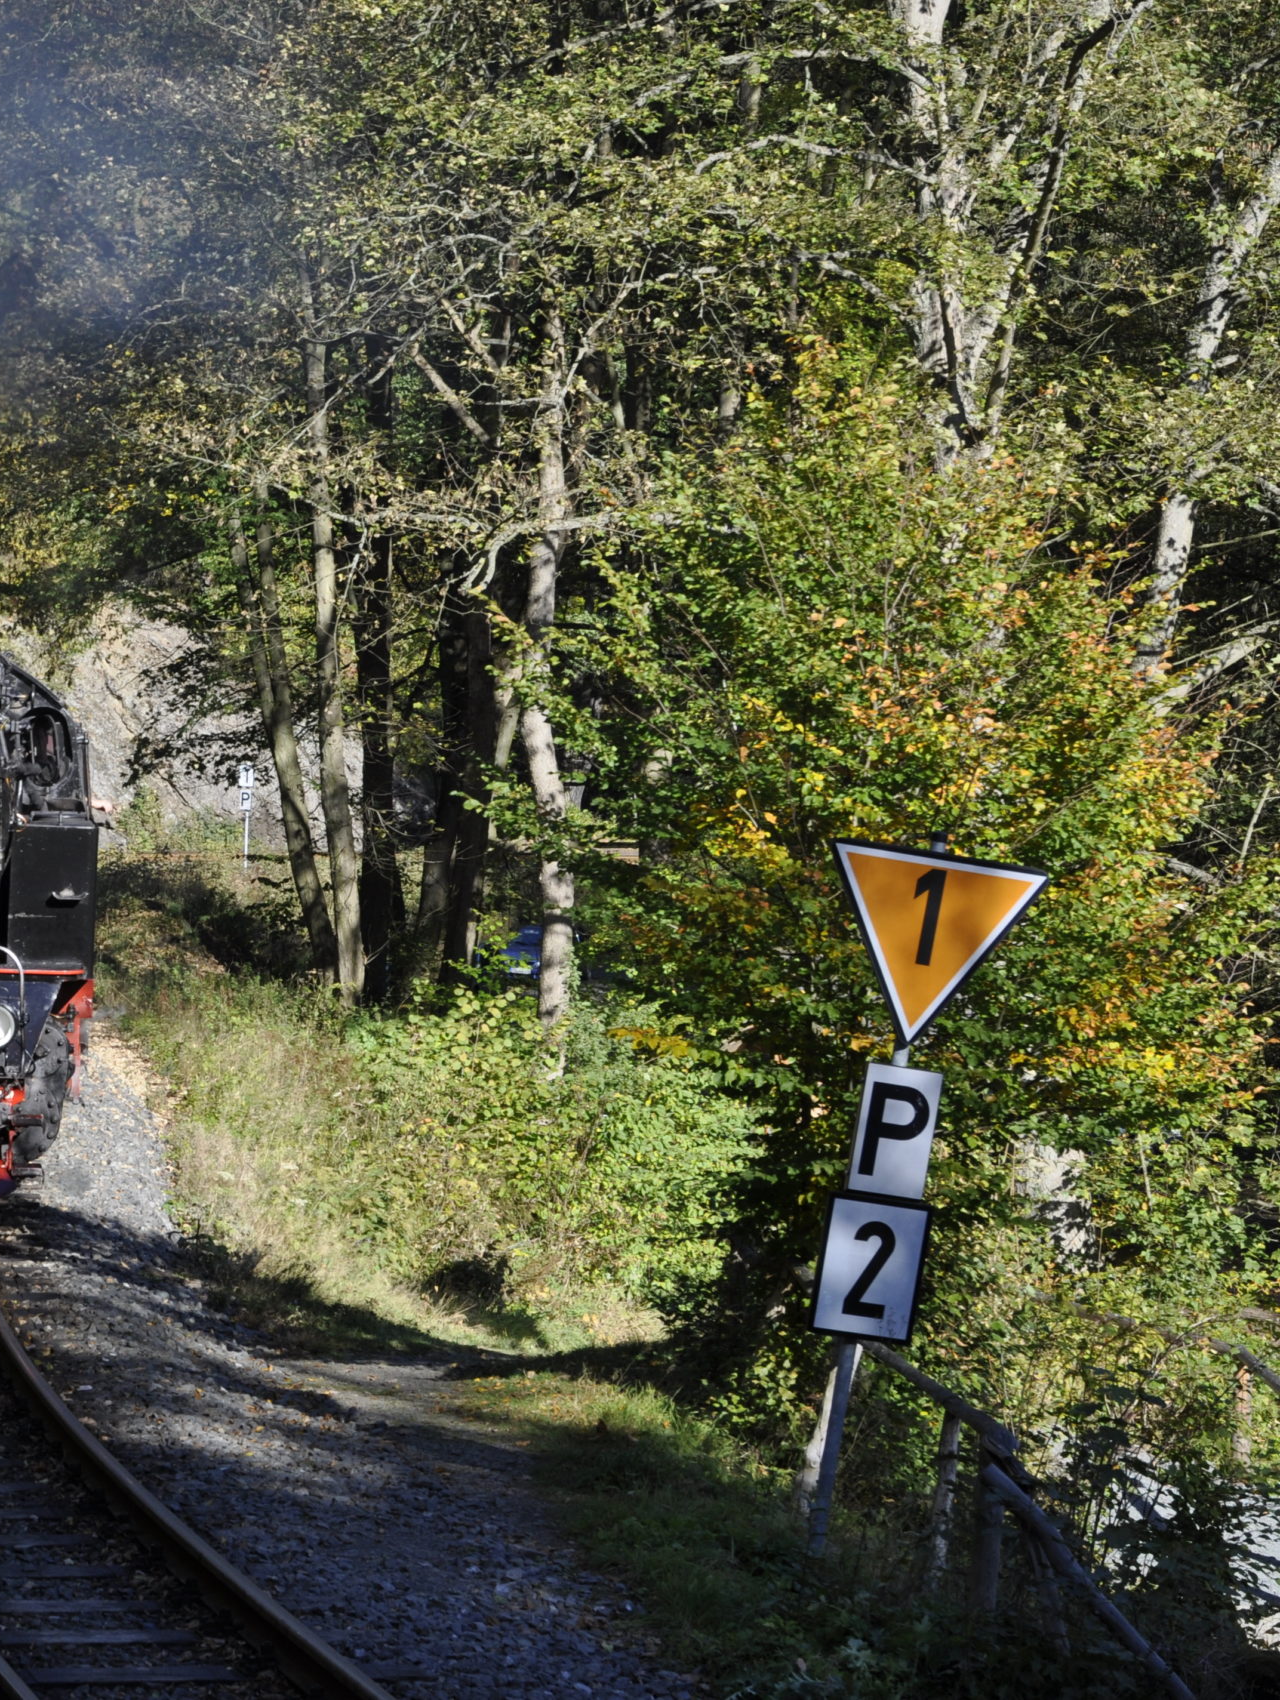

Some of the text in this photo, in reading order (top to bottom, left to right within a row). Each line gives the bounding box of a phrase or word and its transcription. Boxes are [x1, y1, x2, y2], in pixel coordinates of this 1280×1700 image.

[241, 792, 250, 806] P
[913, 868, 947, 967] 1
[857, 1081, 930, 1177] P
[842, 1221, 896, 1318] 2
